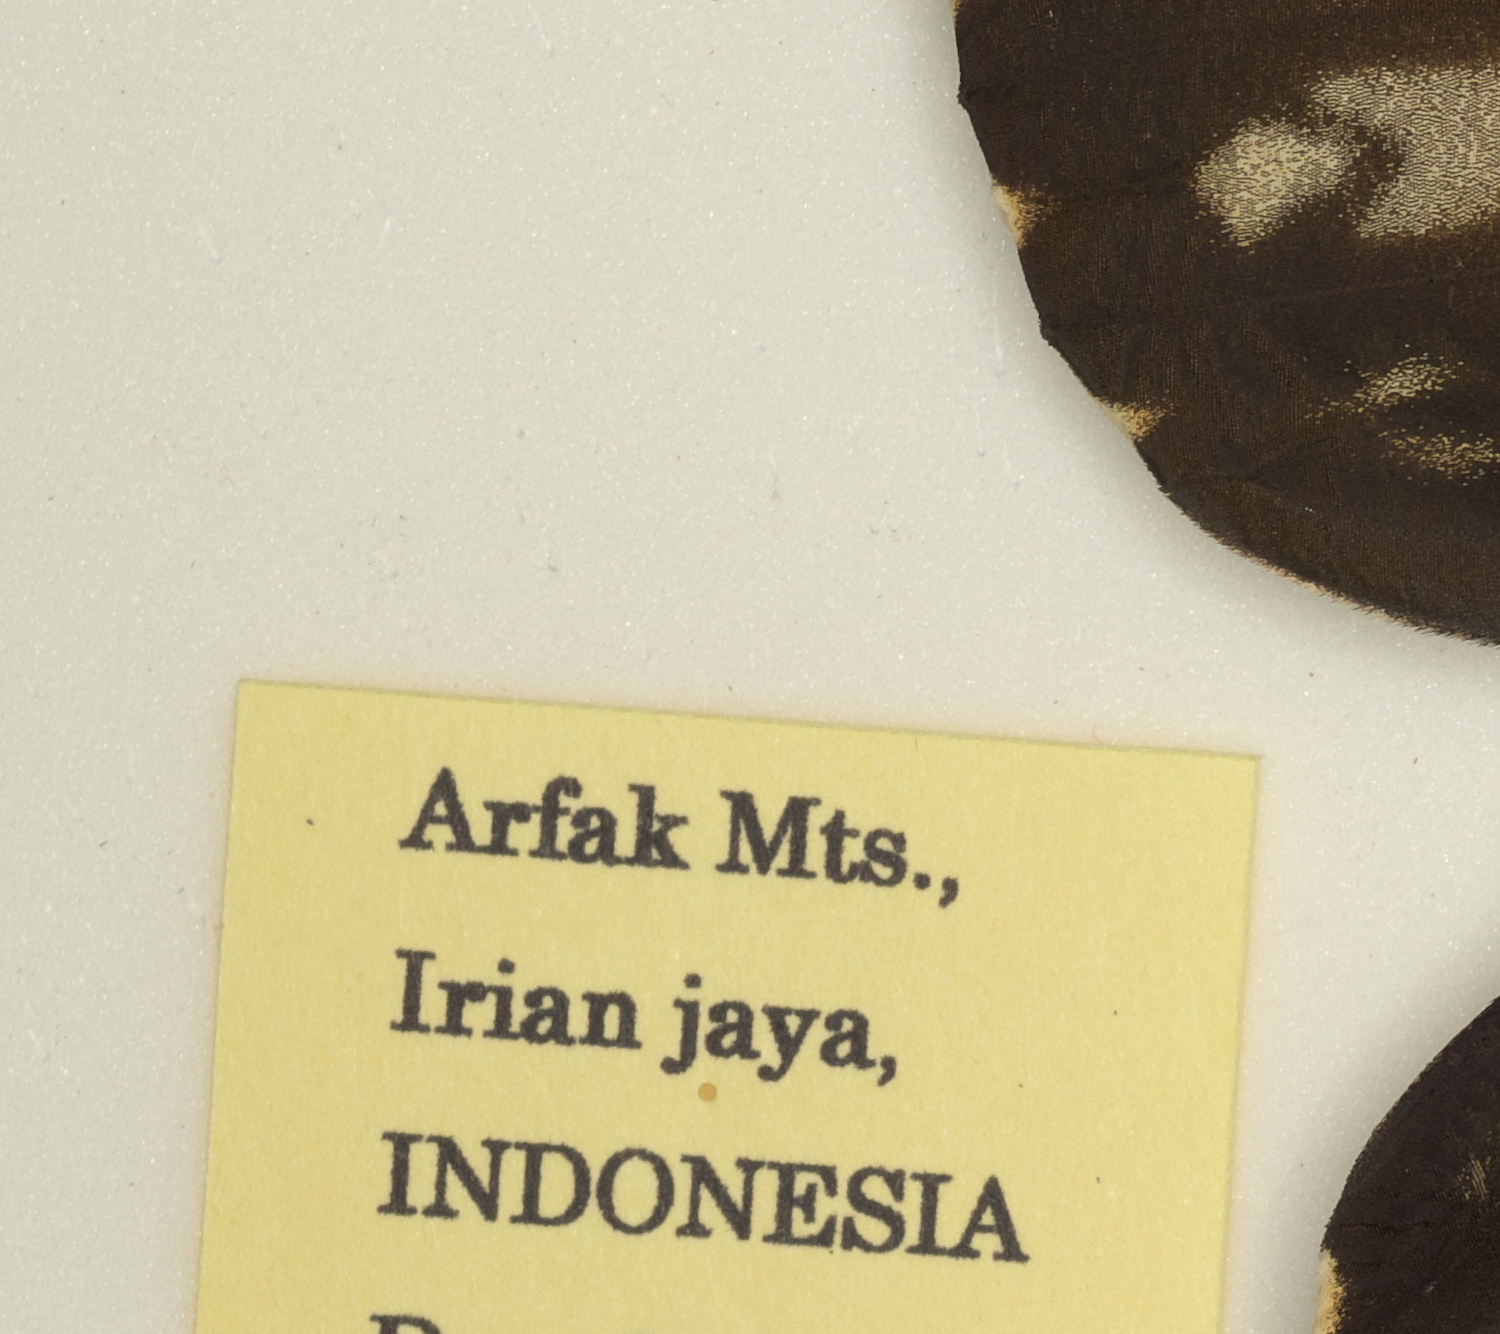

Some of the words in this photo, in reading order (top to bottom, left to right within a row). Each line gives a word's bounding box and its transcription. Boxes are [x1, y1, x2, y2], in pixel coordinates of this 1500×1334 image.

[399, 766, 690, 870] Arfak
[715, 789, 960, 908] Mts.,
[390, 948, 642, 1050] Irian
[660, 973, 897, 1087] jaya,
[376, 1132, 1030, 1264] INDONESIA
